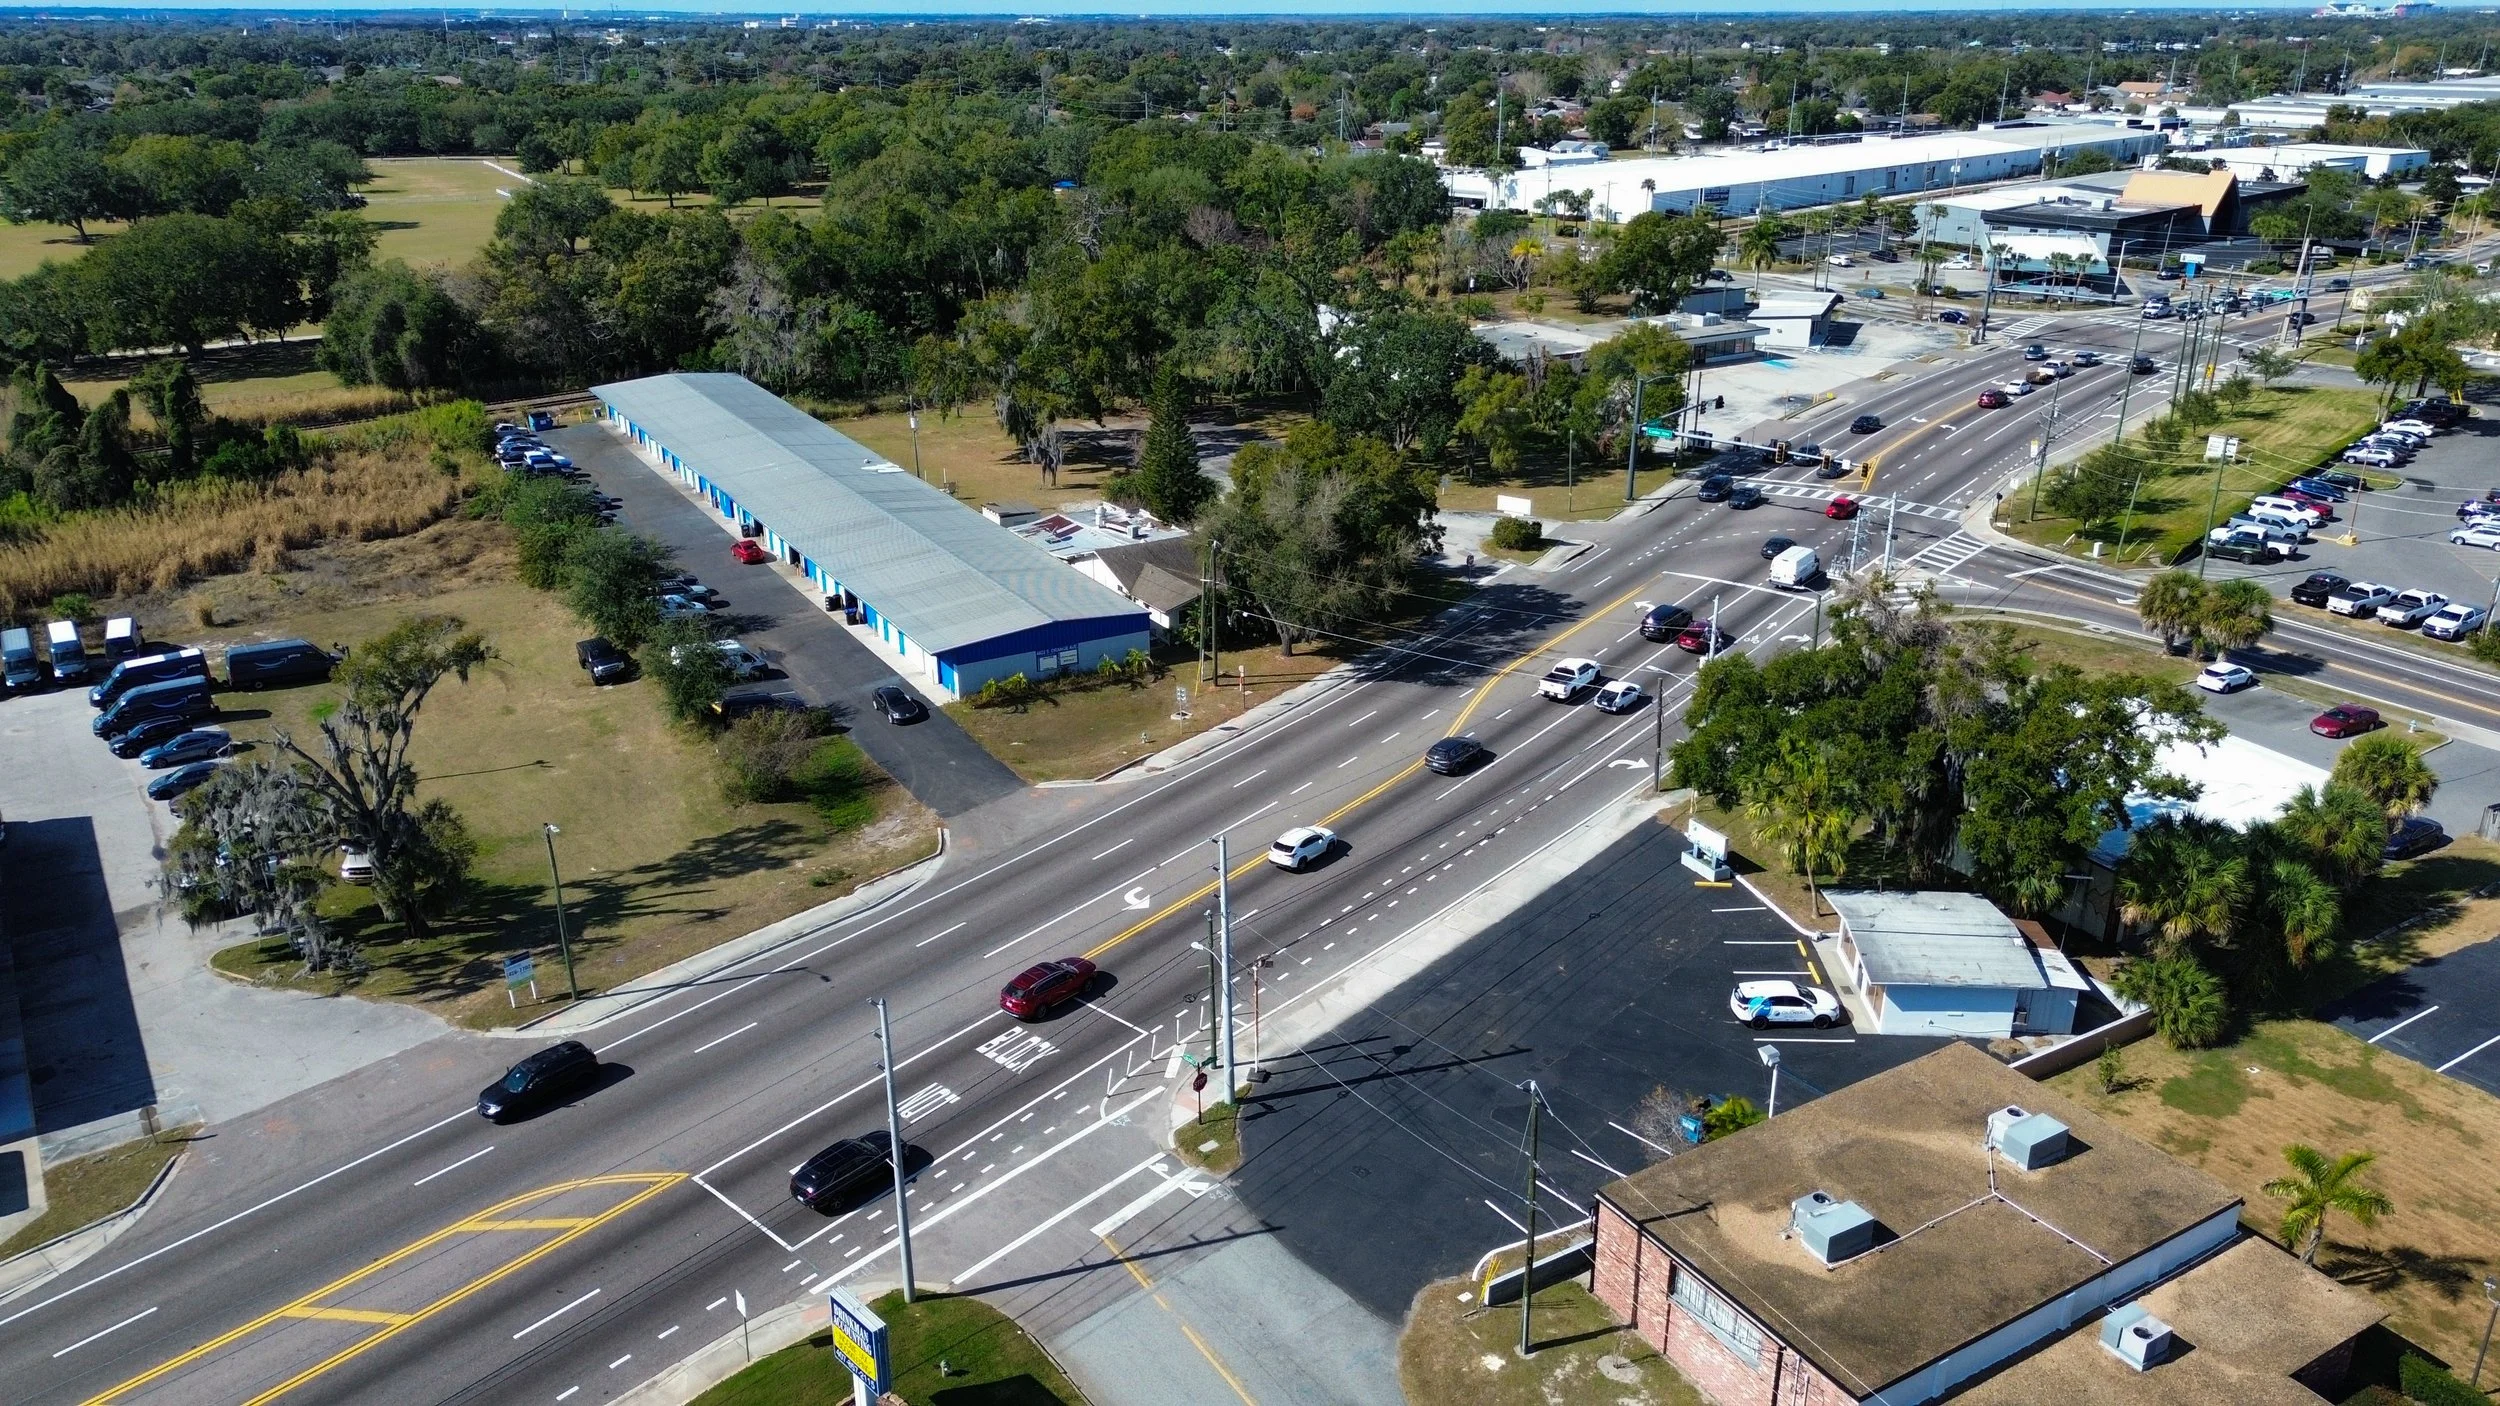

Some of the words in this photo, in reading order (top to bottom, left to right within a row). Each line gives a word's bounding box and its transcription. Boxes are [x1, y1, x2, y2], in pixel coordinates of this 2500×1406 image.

[975, 1026, 1060, 1075] BLOCK
[896, 1082, 961, 1124] NOT
[1194, 1076, 1207, 1089] STOP
[833, 1302, 869, 1342] BRINKMAN
[833, 1314, 872, 1356] ACCOUNTING
